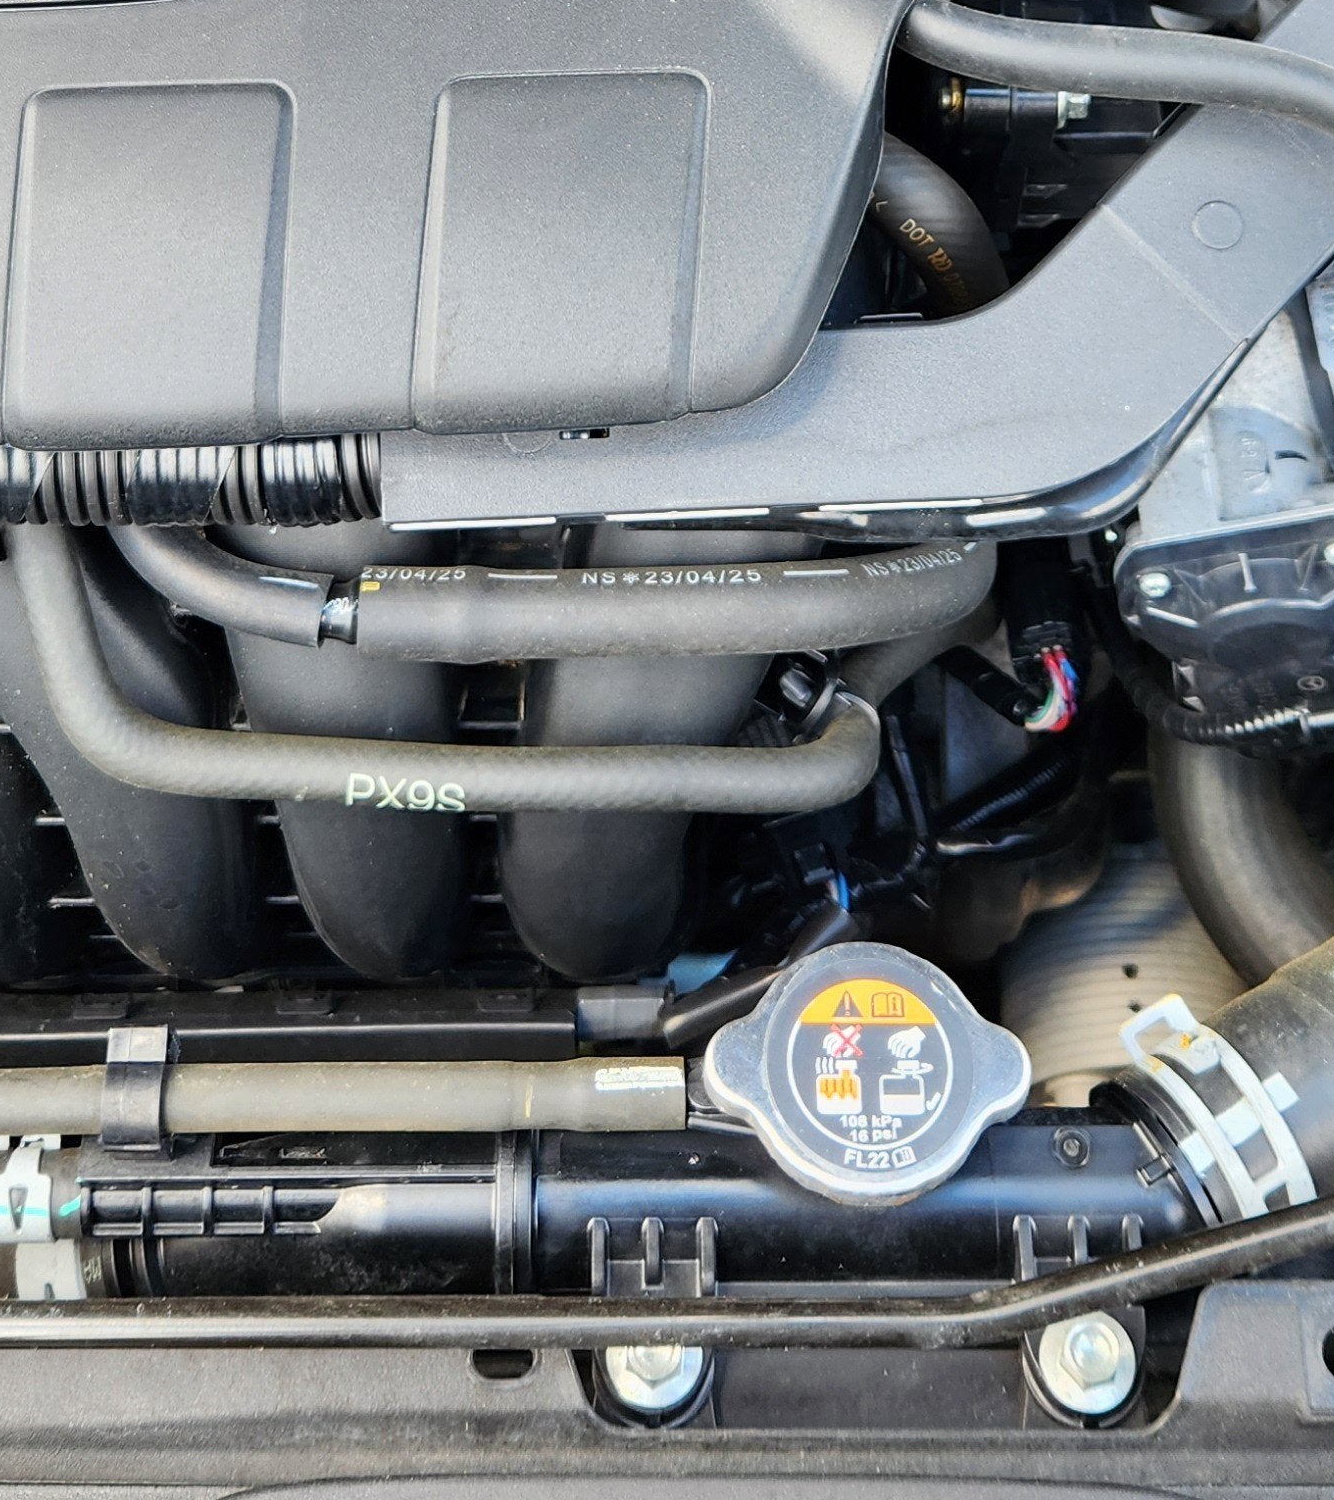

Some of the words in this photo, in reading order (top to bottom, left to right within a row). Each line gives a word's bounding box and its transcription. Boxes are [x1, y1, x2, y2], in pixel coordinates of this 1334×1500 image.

[899, 218, 934, 246] DOT
[361, 567, 466, 580] 23/04/25
[582, 571, 616, 585] NS
[644, 569, 762, 584] 23/04/25
[345, 772, 466, 812] PX9S
[839, 1114, 868, 1129] 108
[871, 1114, 903, 1129] kPa
[849, 1128, 870, 1143] 16
[843, 1147, 892, 1169] FL22
